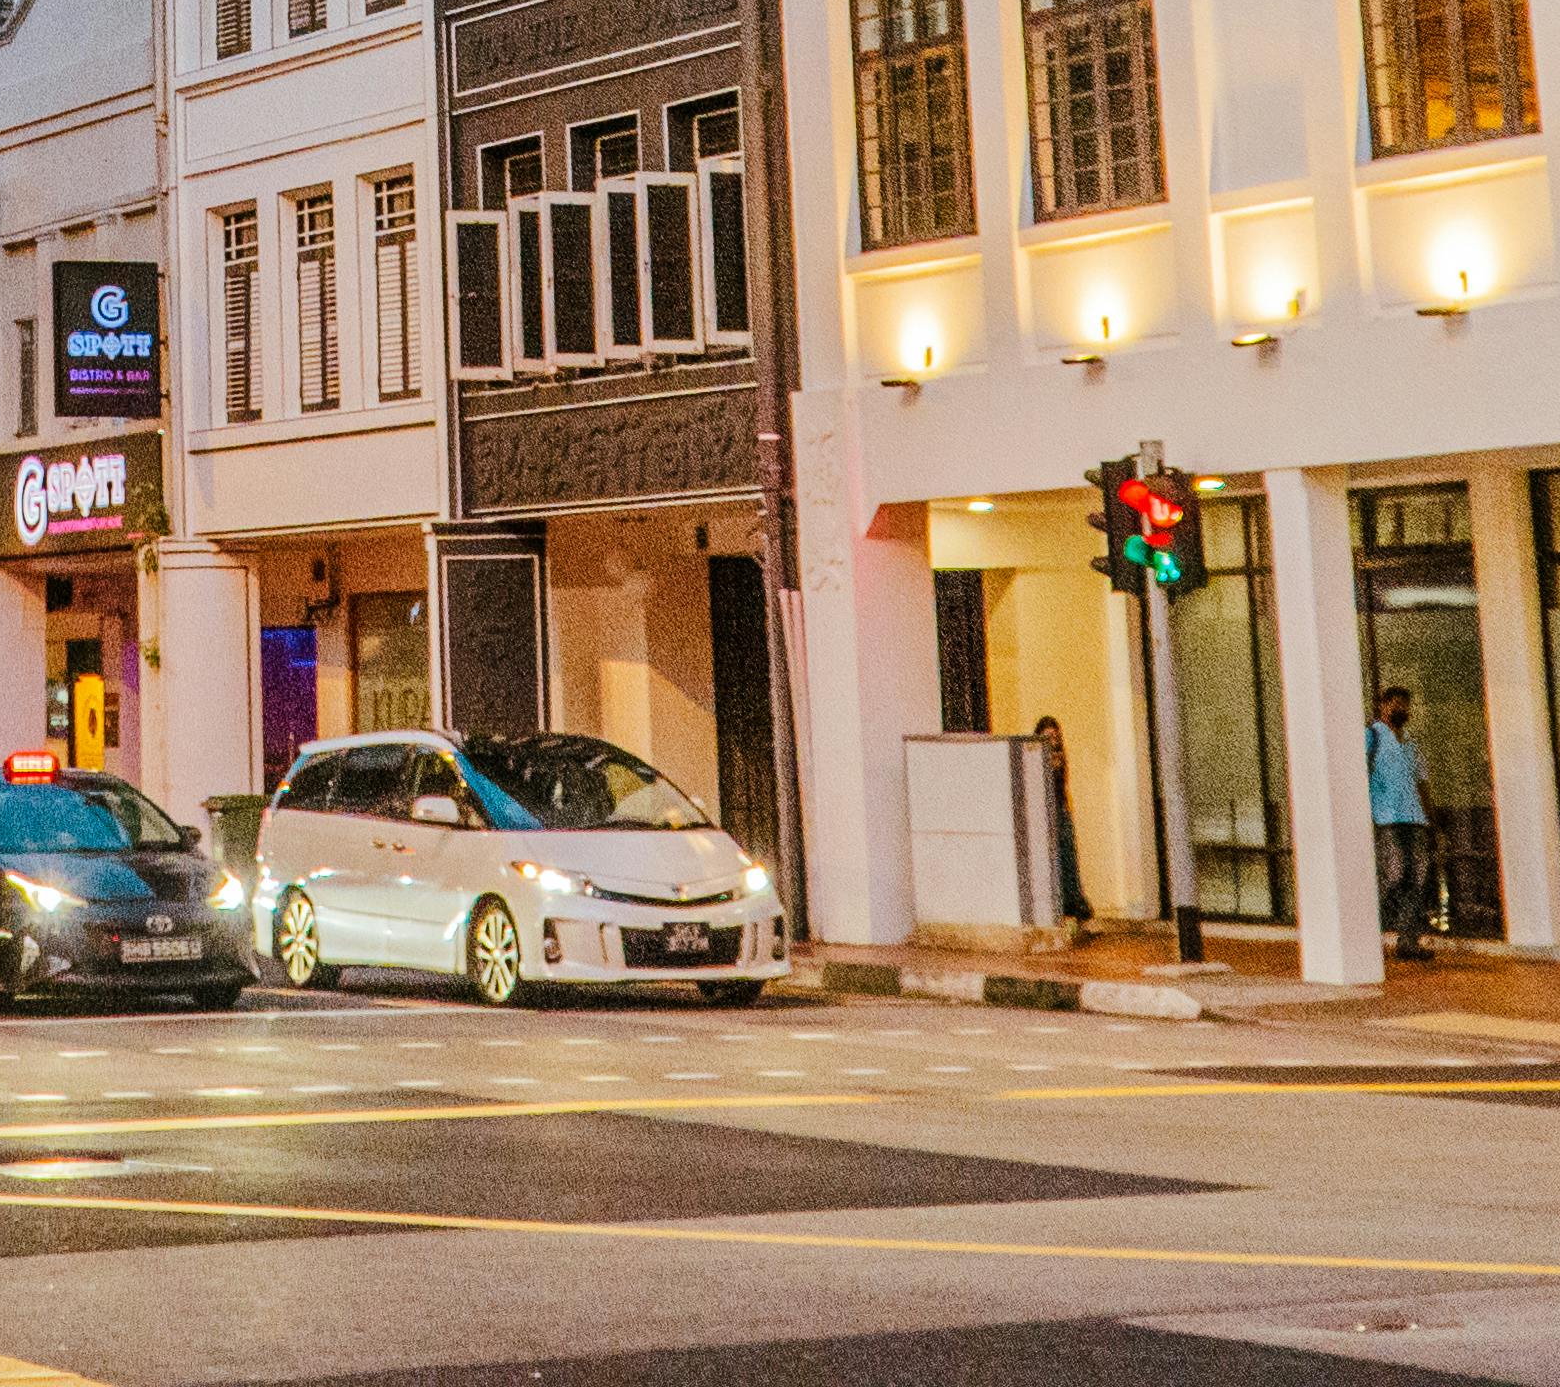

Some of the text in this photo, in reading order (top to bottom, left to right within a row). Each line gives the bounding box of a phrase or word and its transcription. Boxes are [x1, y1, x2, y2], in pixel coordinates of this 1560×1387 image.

[91, 284, 129, 329] G
[69, 369, 114, 382] BISTRO
[126, 369, 151, 382] BAR
